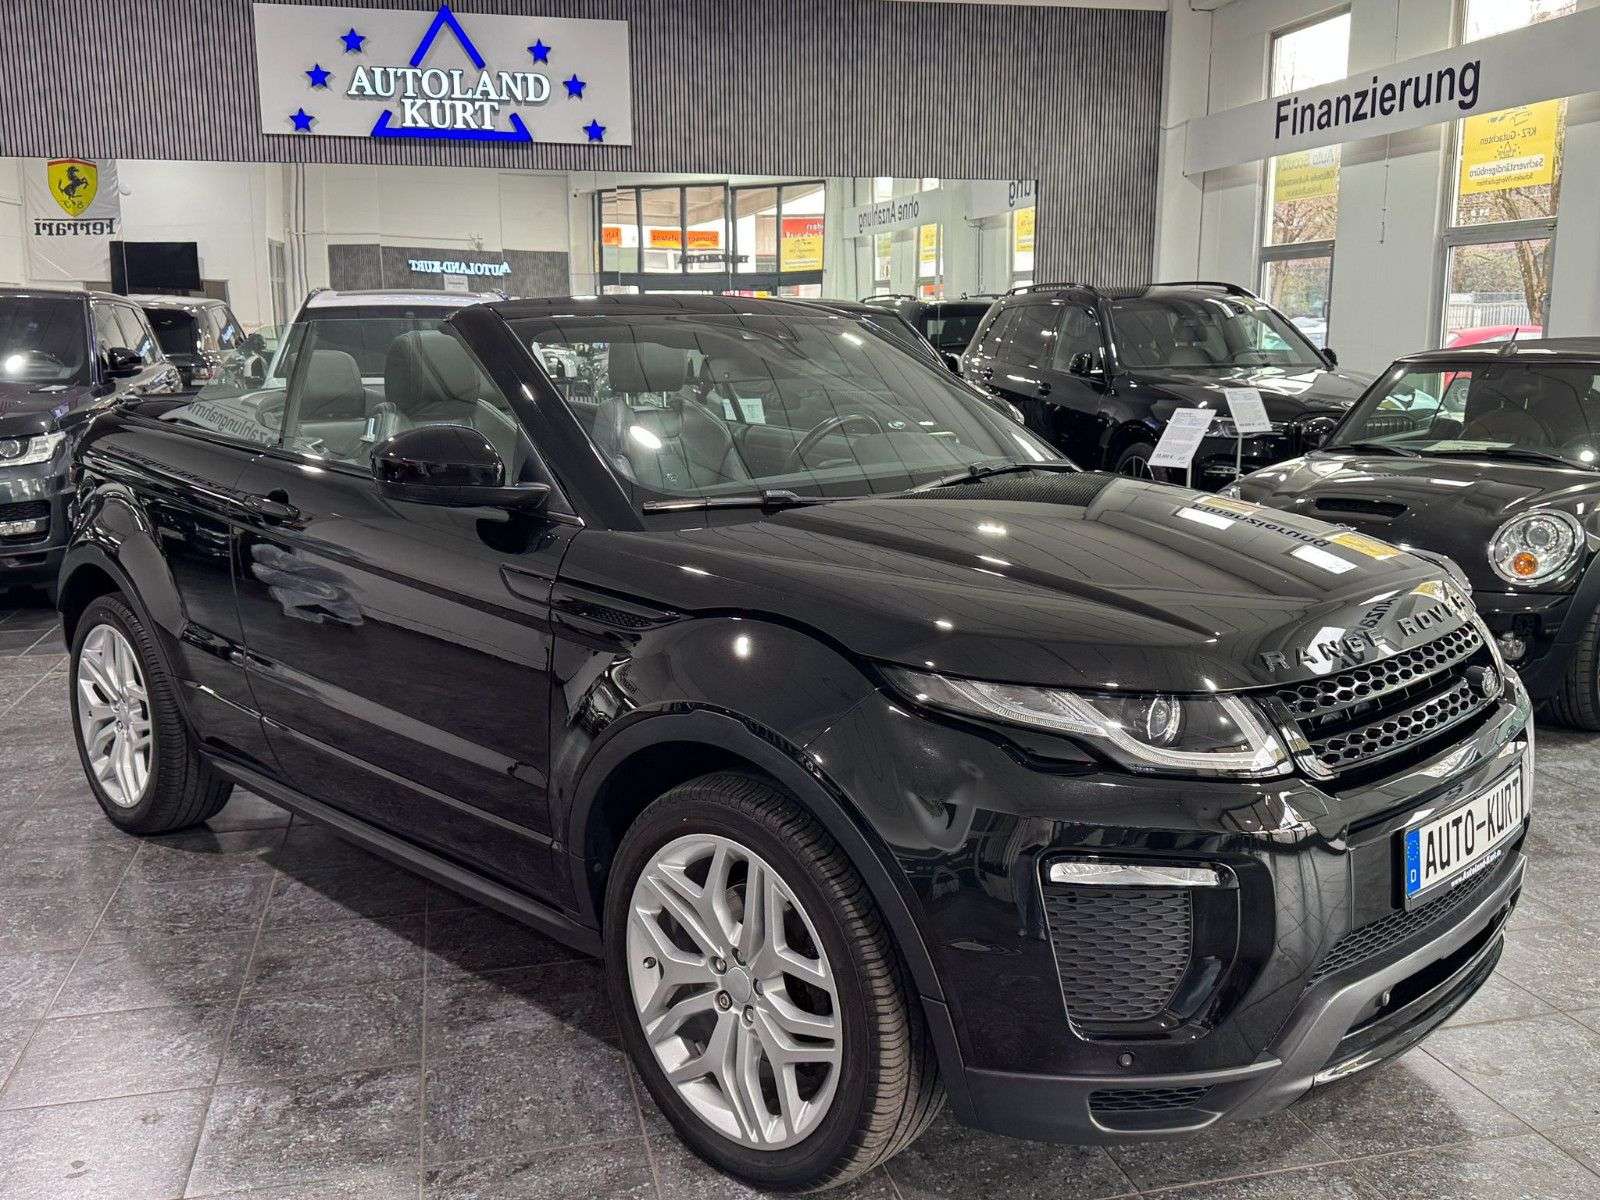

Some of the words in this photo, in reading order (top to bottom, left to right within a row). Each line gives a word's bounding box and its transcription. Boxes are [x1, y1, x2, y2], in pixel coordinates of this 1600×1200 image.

[347, 66, 551, 102] AUTOLAND
[1275, 59, 1481, 140] Finanzierung
[401, 98, 499, 130] KURT
[1425, 776, 1520, 880] AUTO-KURT
